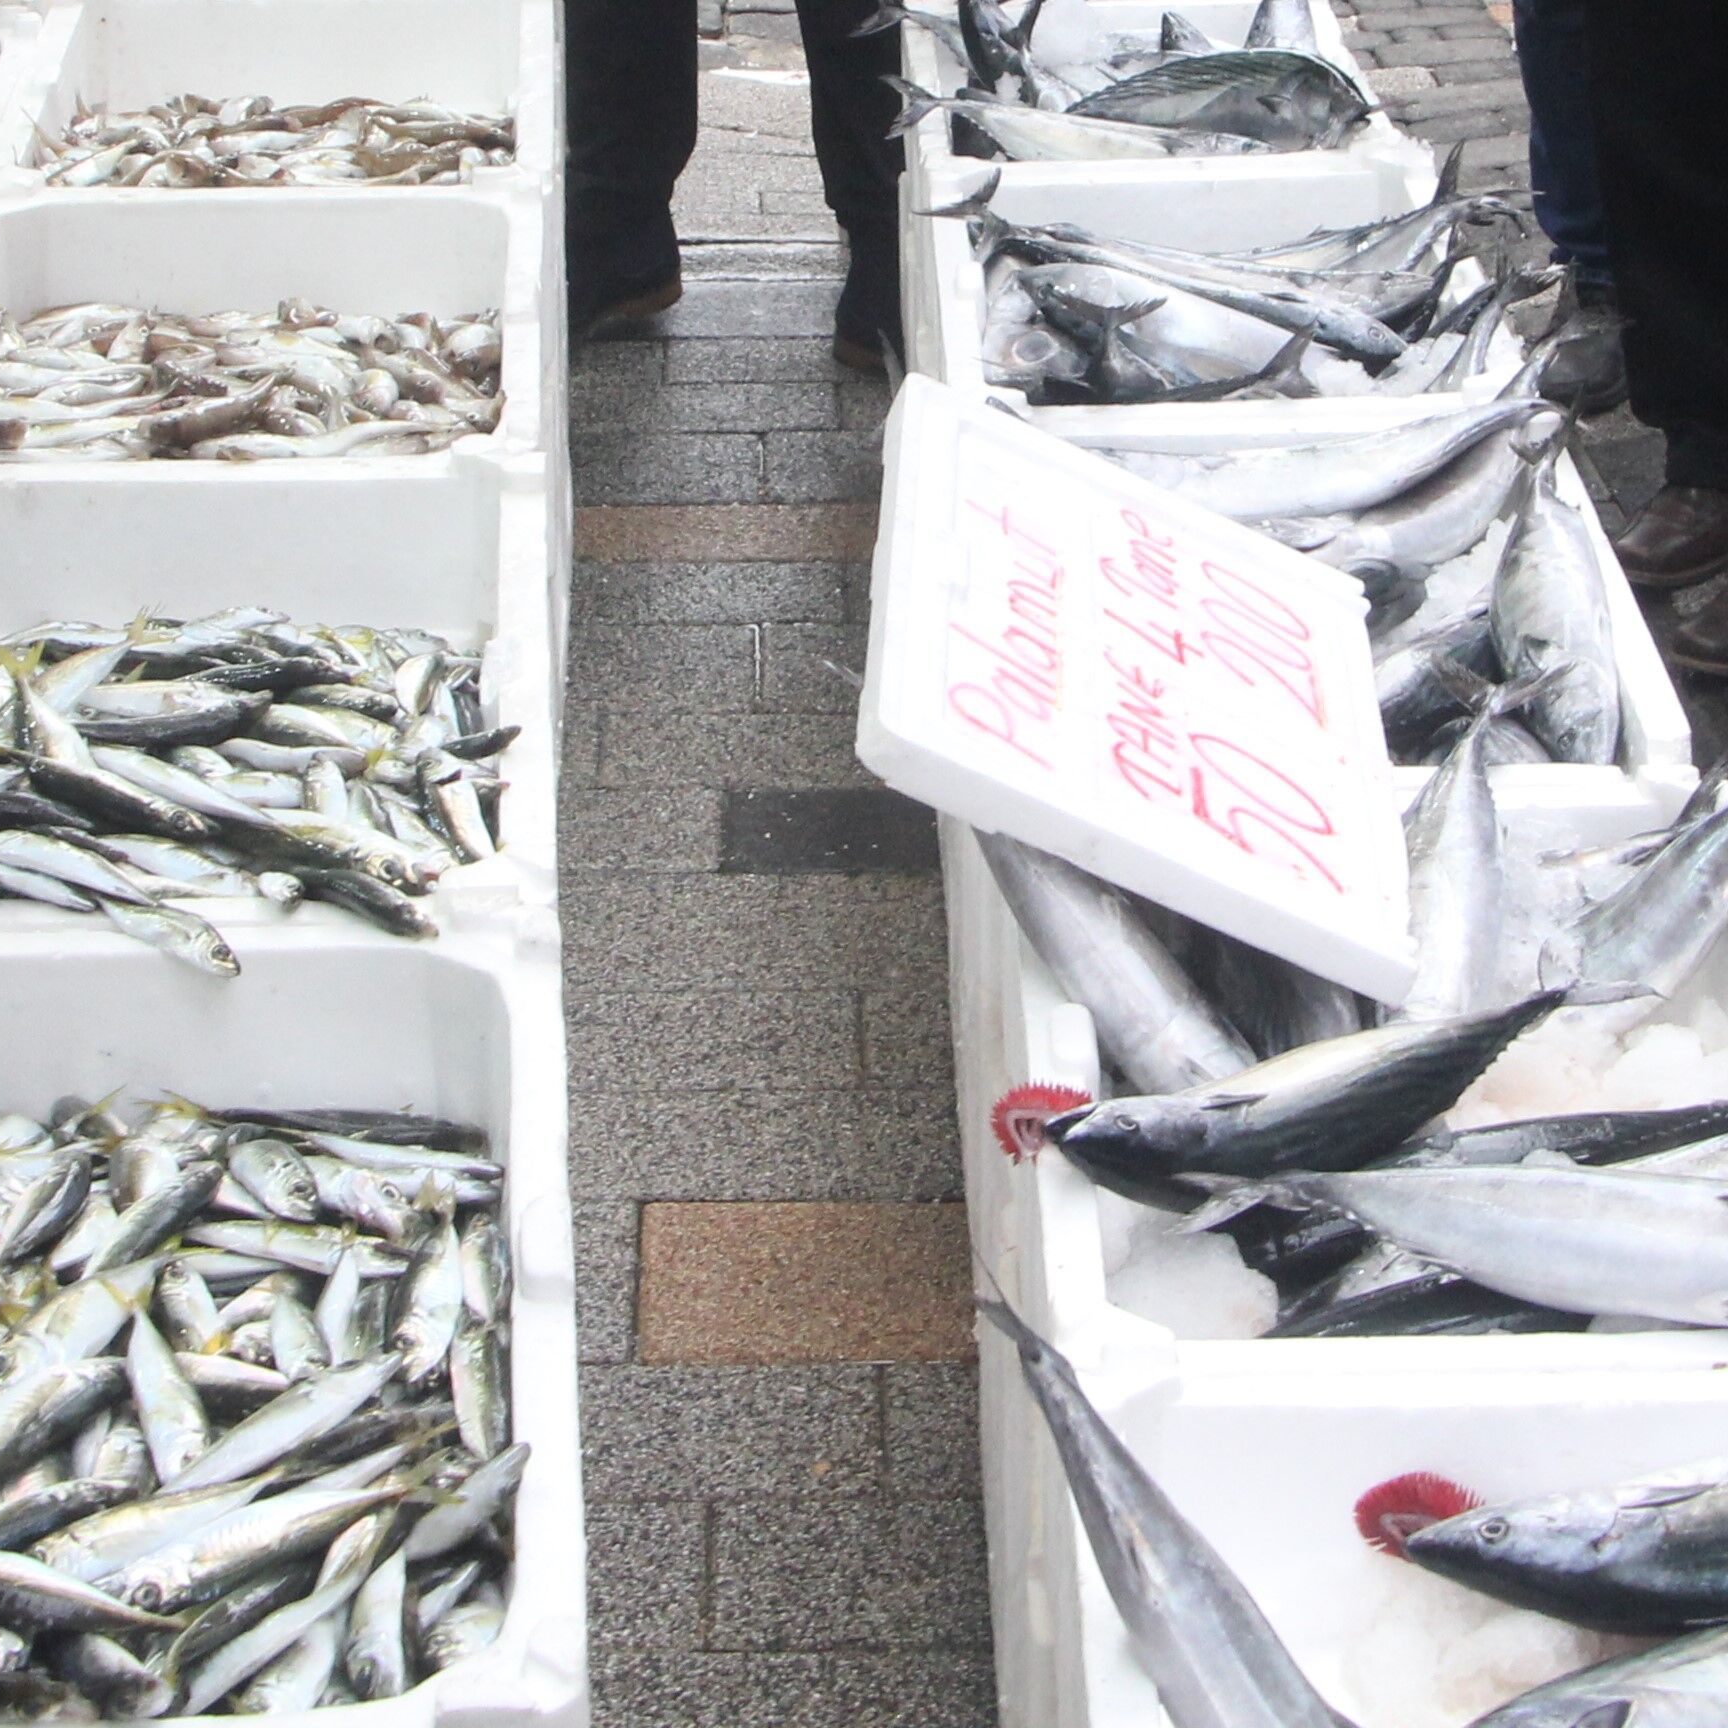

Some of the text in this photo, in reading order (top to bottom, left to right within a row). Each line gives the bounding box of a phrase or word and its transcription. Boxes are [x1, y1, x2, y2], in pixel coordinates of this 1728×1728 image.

[948, 499, 1062, 770] Palamut
[1099, 509, 1204, 800] TANE 4 Tane
[1188, 561, 1343, 894] 50 200
